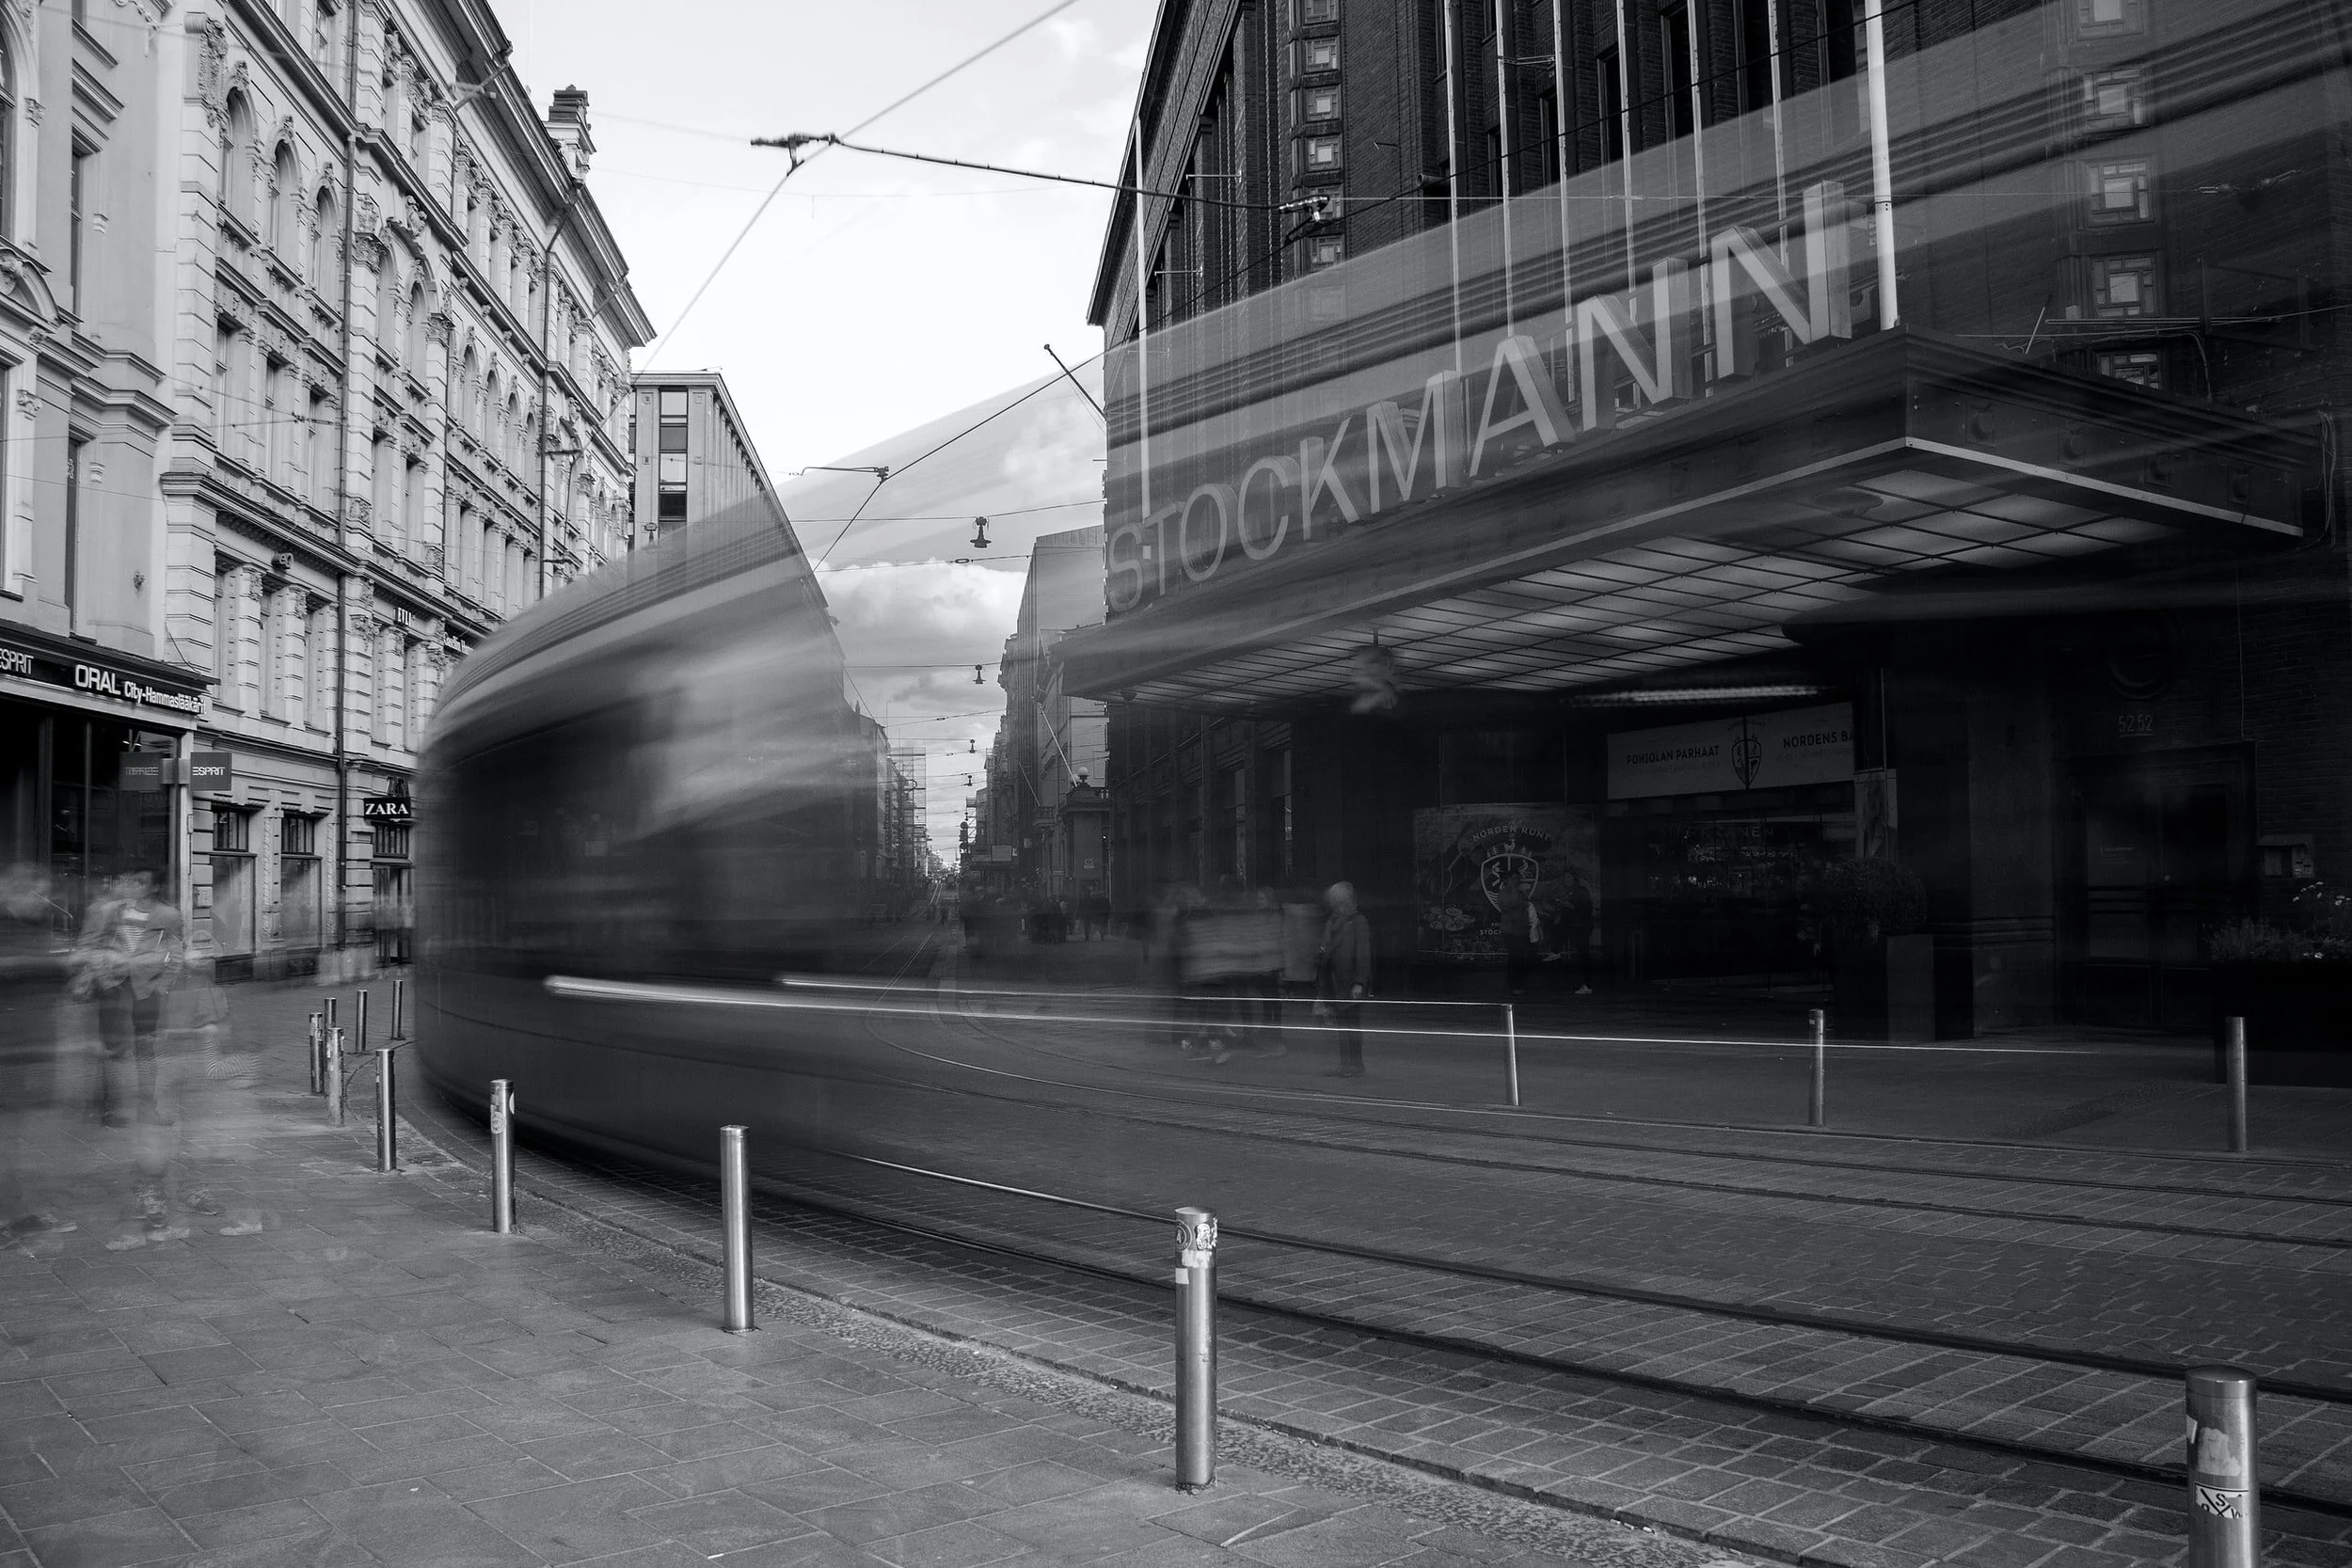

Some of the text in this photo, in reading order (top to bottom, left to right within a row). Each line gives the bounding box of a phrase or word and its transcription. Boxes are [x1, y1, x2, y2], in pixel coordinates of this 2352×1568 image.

[1109, 180, 1850, 613] STOCKMANN
[74, 664, 121, 695] ORAL
[1783, 731, 1838, 749] NORDENS
[1626, 745, 1720, 766] POHJOLAN PARHAAT
[192, 767, 226, 776] ESPRIT
[365, 802, 409, 815] ZARA
[1470, 825, 1518, 842] NORDEN
